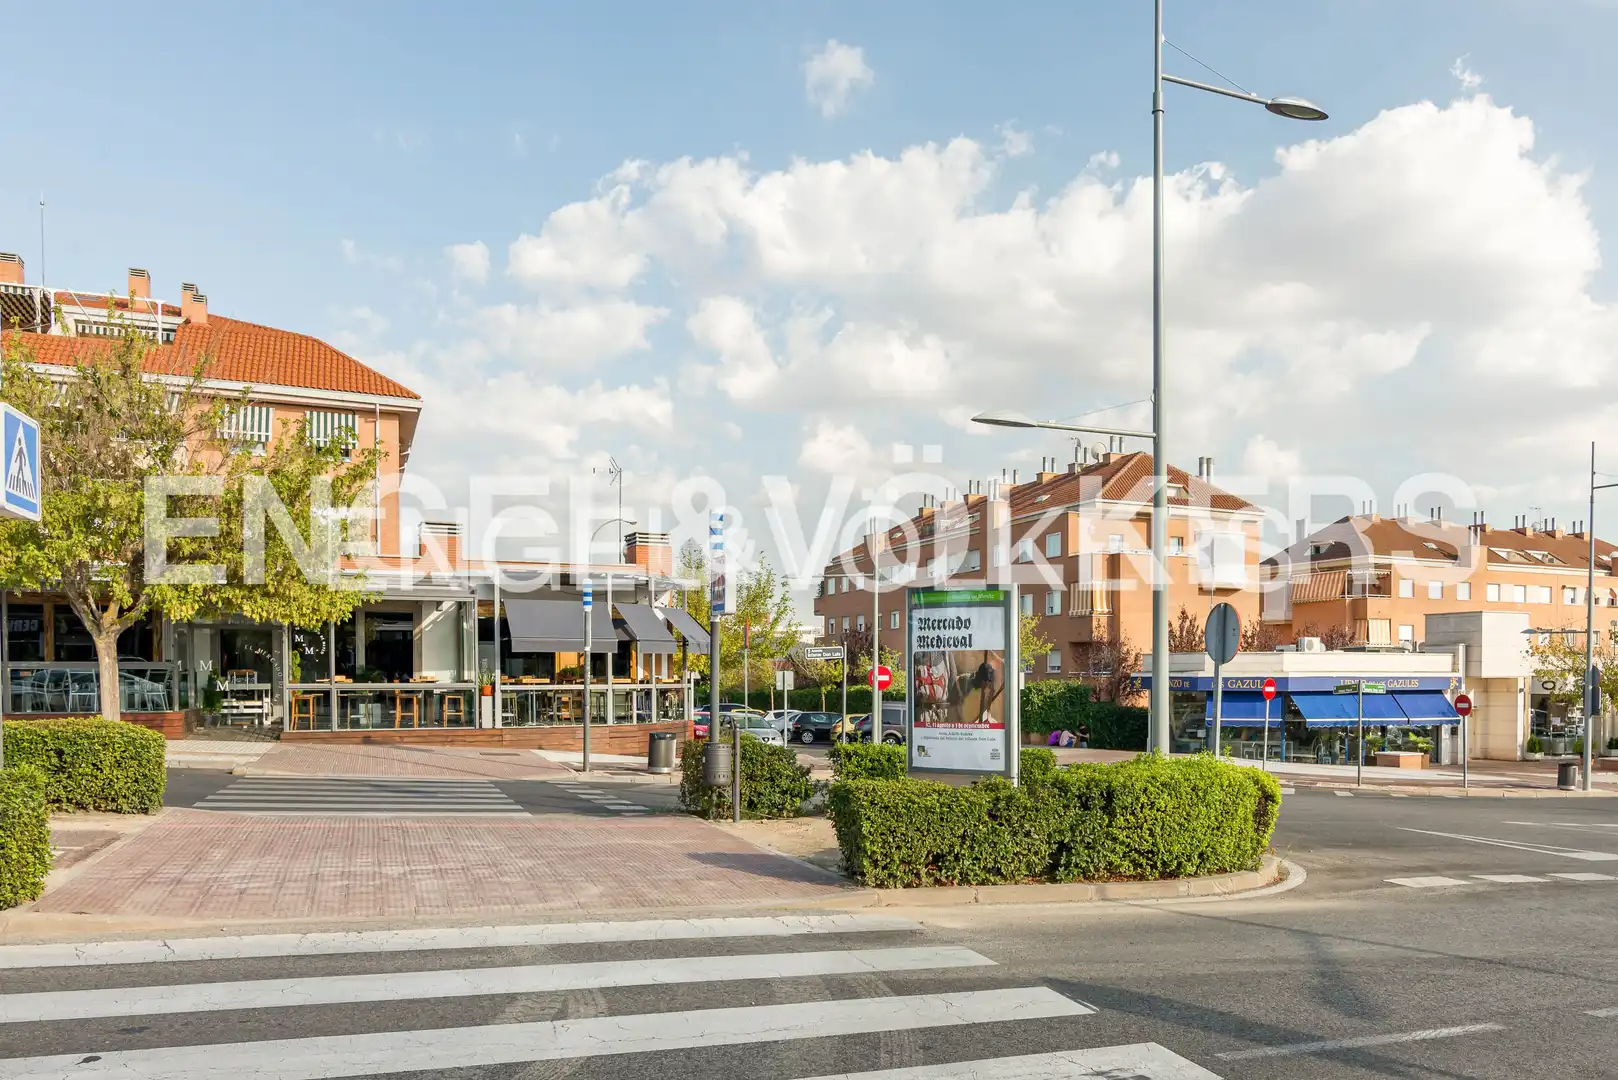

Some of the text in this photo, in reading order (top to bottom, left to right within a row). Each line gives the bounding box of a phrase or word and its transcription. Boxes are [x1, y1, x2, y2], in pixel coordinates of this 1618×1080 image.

[917, 616, 971, 632] Mercado
[917, 633, 973, 649] Medieval
[1227, 679, 1264, 689] GAZUL
[1387, 679, 1419, 688] GAZULES
